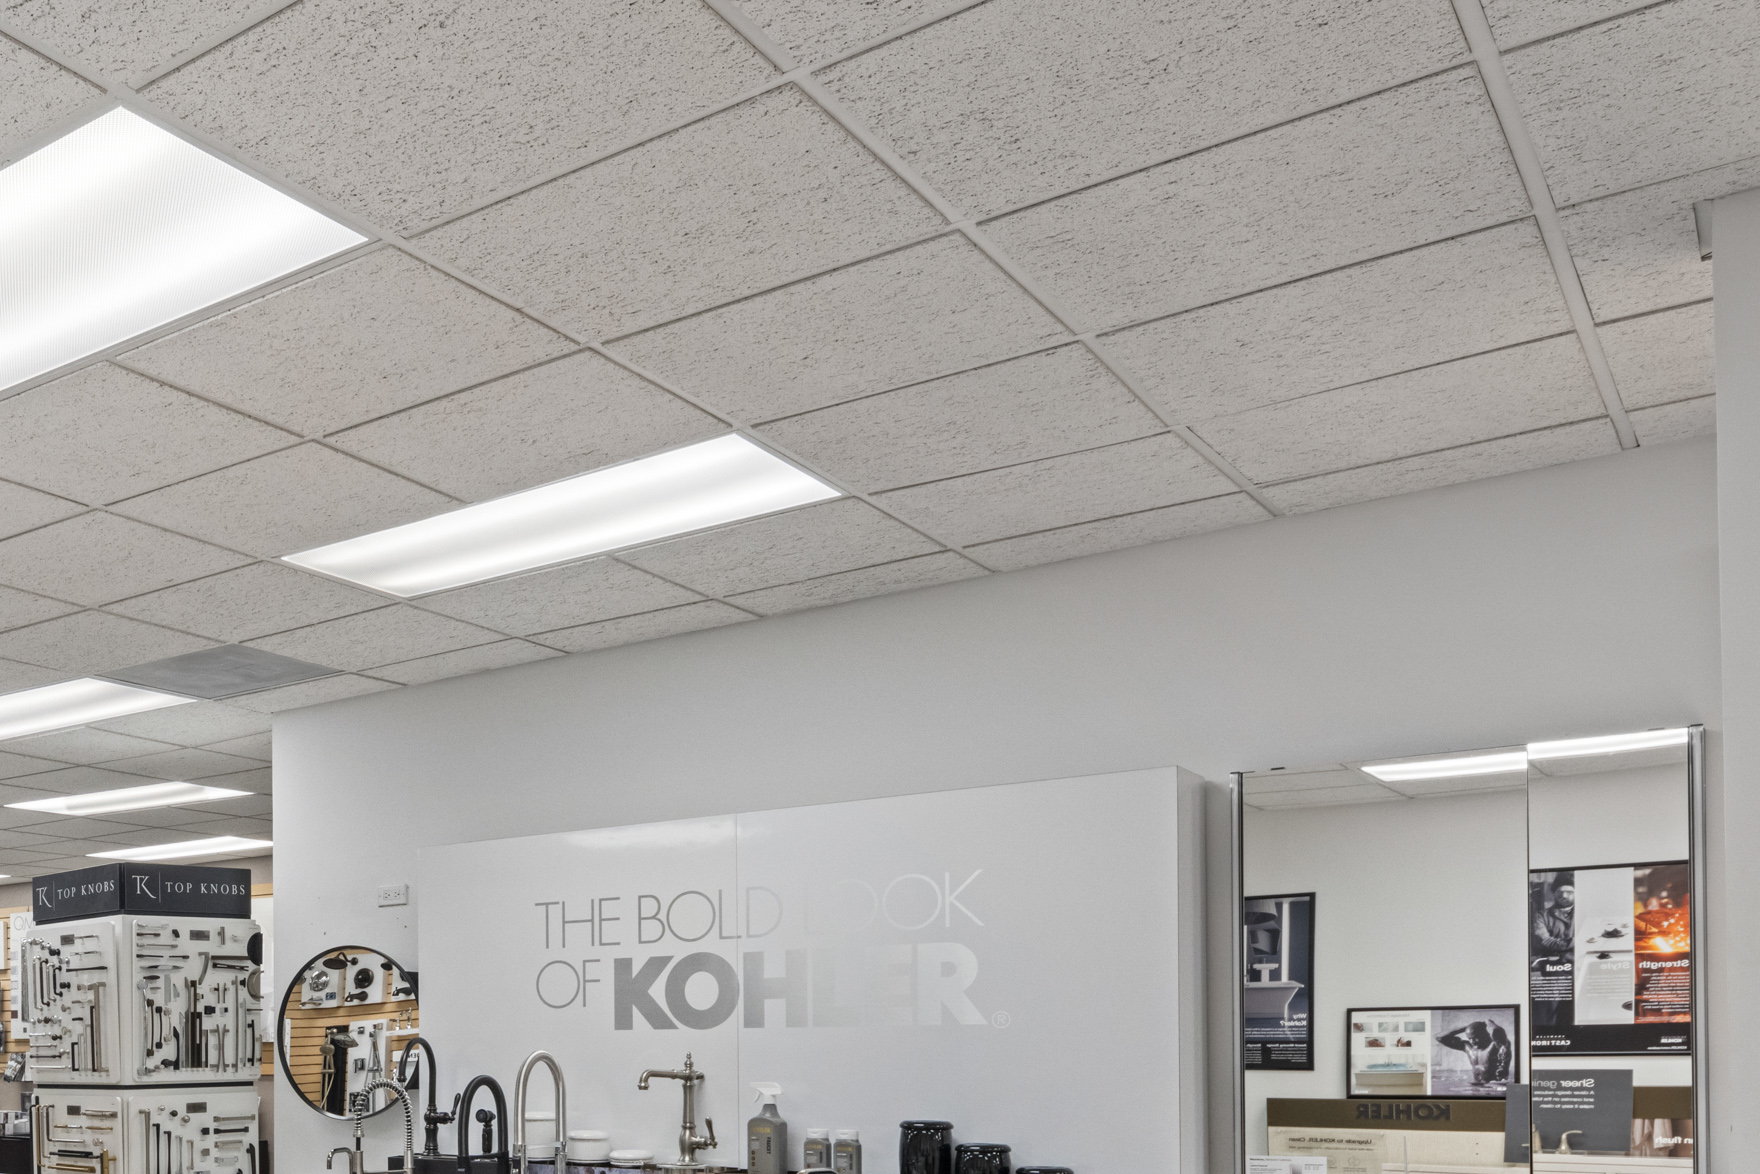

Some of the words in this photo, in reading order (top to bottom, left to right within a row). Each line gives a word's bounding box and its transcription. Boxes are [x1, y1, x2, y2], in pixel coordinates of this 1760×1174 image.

[57, 887, 76, 900] TOP
[81, 880, 115, 896] KNOBS
[165, 881, 193, 893] TOP
[200, 883, 246, 896] KNOBS
[535, 896, 621, 949] THE
[638, 886, 783, 944] BOLD
[803, 869, 985, 936] LOOK
[536, 958, 601, 1009] OF
[614, 942, 989, 1031] KOHLER
